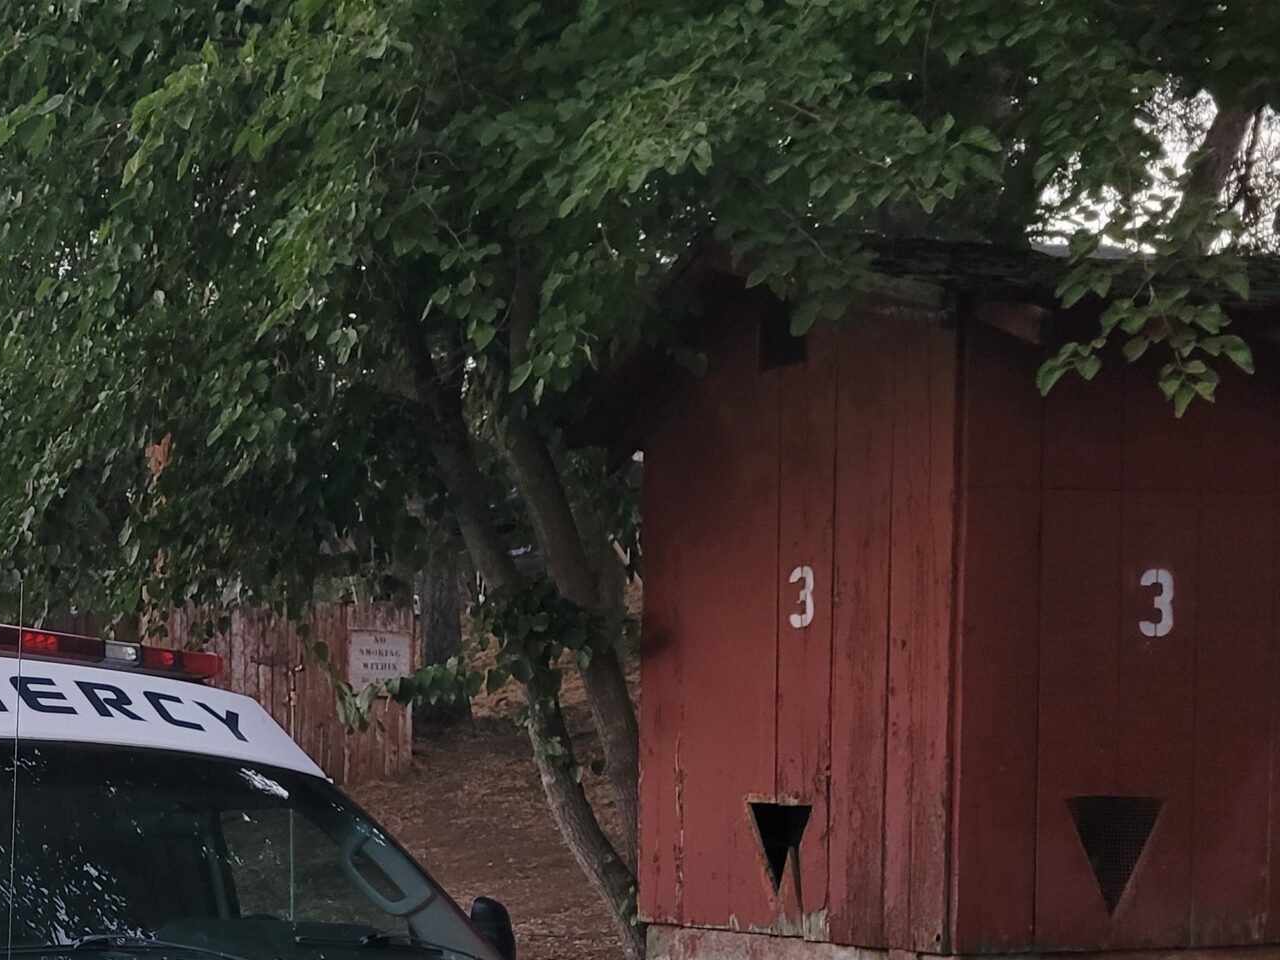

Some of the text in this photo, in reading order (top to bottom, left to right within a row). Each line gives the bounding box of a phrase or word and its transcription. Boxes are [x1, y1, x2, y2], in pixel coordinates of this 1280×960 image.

[789, 566, 814, 628] 3
[1139, 568, 1174, 637] 3
[374, 635, 386, 644] NO
[360, 648, 401, 657] SMOKING
[362, 662, 398, 671] WITHIN
